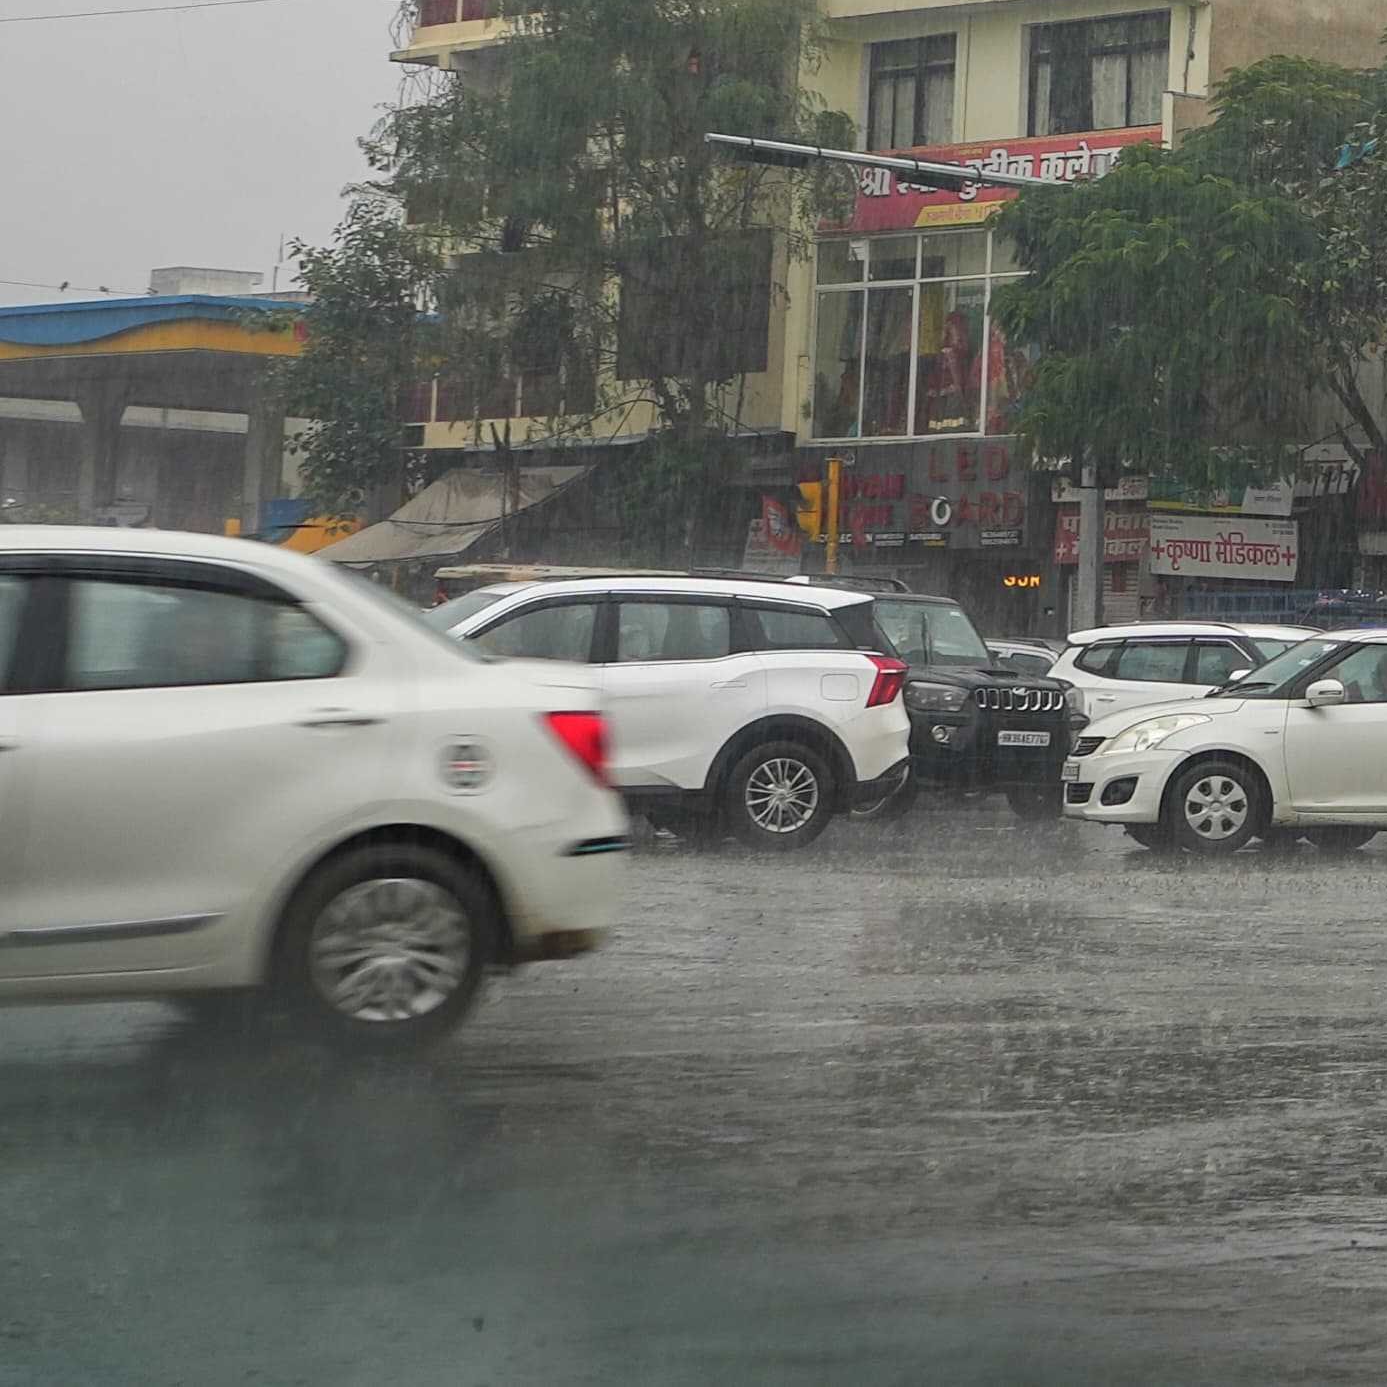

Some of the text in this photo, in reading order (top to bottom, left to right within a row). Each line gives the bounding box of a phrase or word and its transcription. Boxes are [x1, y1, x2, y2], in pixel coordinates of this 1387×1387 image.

[928, 445, 1010, 483] LED
[909, 491, 1025, 529] BOARD
[1166, 532, 1281, 571] कृष्णा मेडिकल
